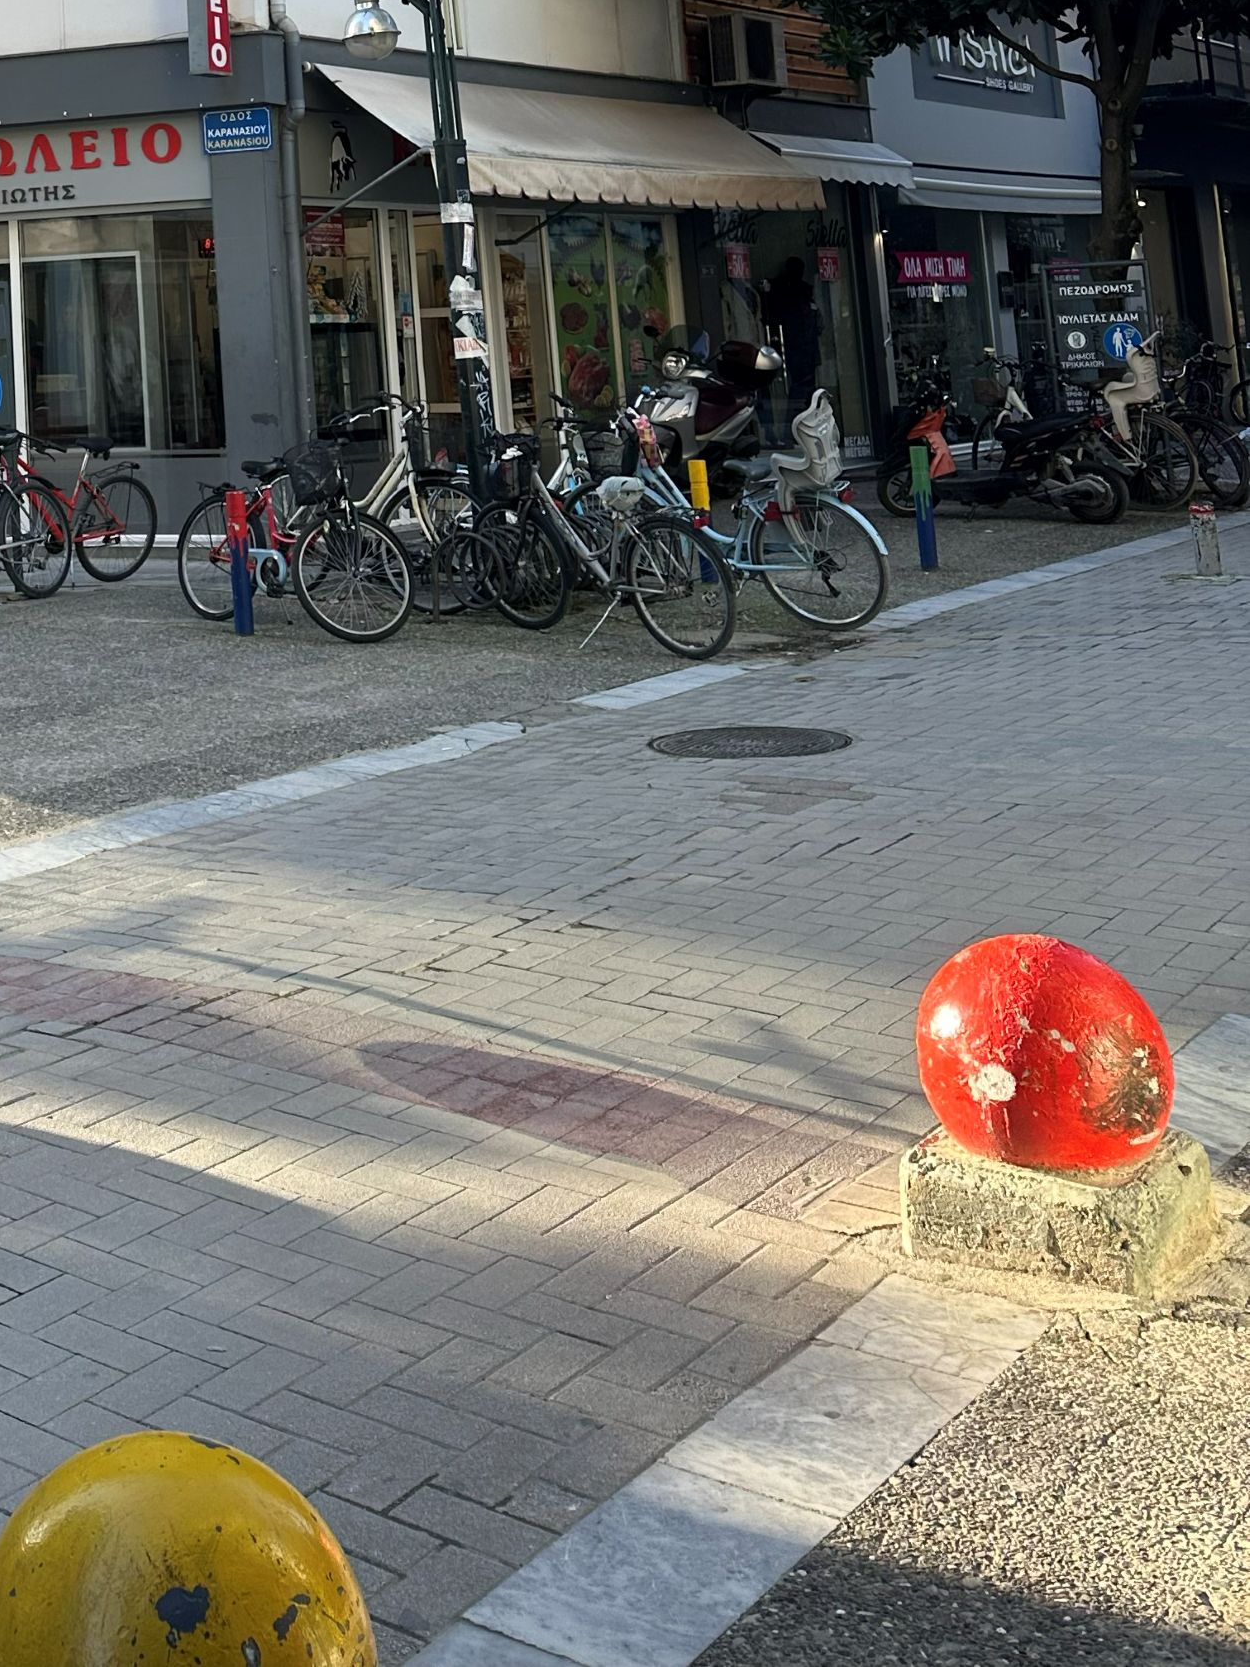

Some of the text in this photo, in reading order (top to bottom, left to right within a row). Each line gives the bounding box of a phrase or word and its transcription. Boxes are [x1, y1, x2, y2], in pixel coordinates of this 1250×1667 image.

[986, 77, 1006, 89] SHOES
[220, 111, 252, 122] ΟΔΟΣ
[207, 125, 267, 138] ΚΑΡΑΝΑΣΙΟΥ
[207, 136, 269, 149] KARANASIOU
[904, 257, 922, 278] ΟΛΑ
[1059, 284, 1134, 296] ΠΕΖΟΔΡΟΜΟΣ
[1109, 313, 1139, 323] ΑΔΑΜ
